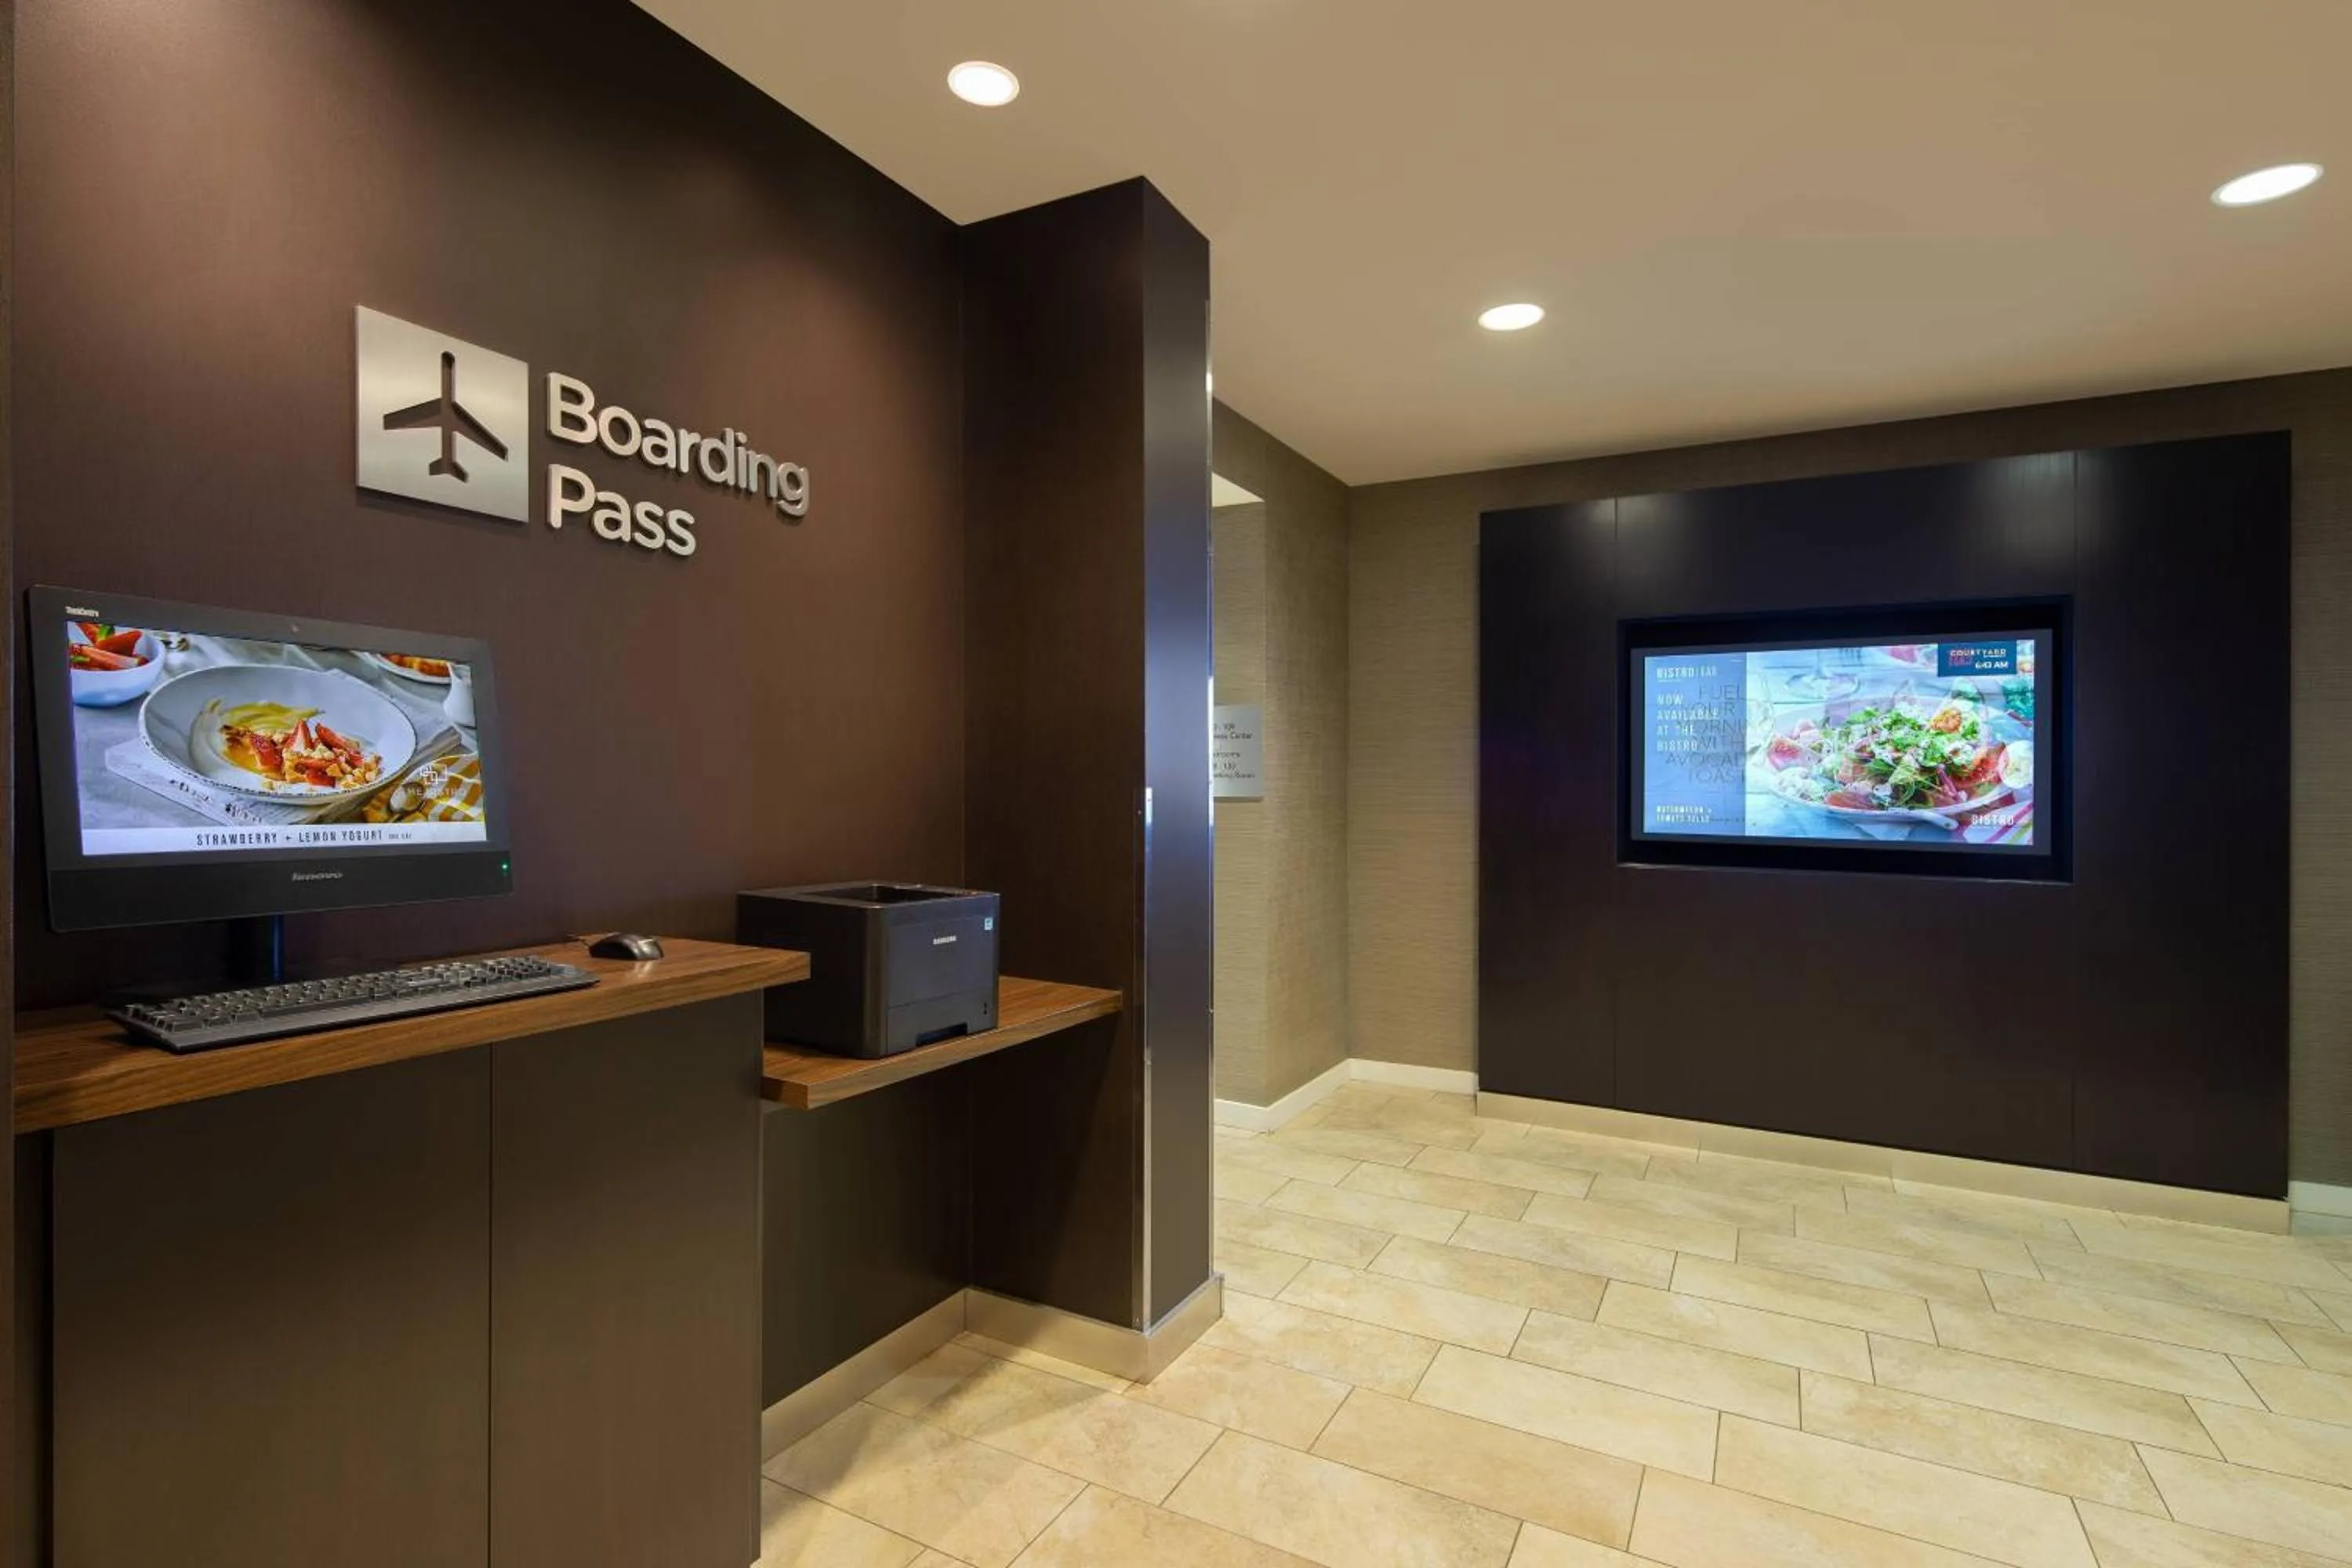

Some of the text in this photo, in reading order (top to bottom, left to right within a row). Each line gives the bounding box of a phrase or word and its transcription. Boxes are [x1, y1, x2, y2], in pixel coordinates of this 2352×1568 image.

[547, 372, 810, 517] Boarding
[547, 463, 697, 556] Pass
[1656, 694, 1684, 705] NOW
[1656, 707, 1720, 720] AVAILABLE
[1656, 724, 1669, 735] AT
[197, 832, 278, 846] STRAWBERRY
[299, 831, 336, 843] LEMON
[341, 829, 383, 841] YOGURT
